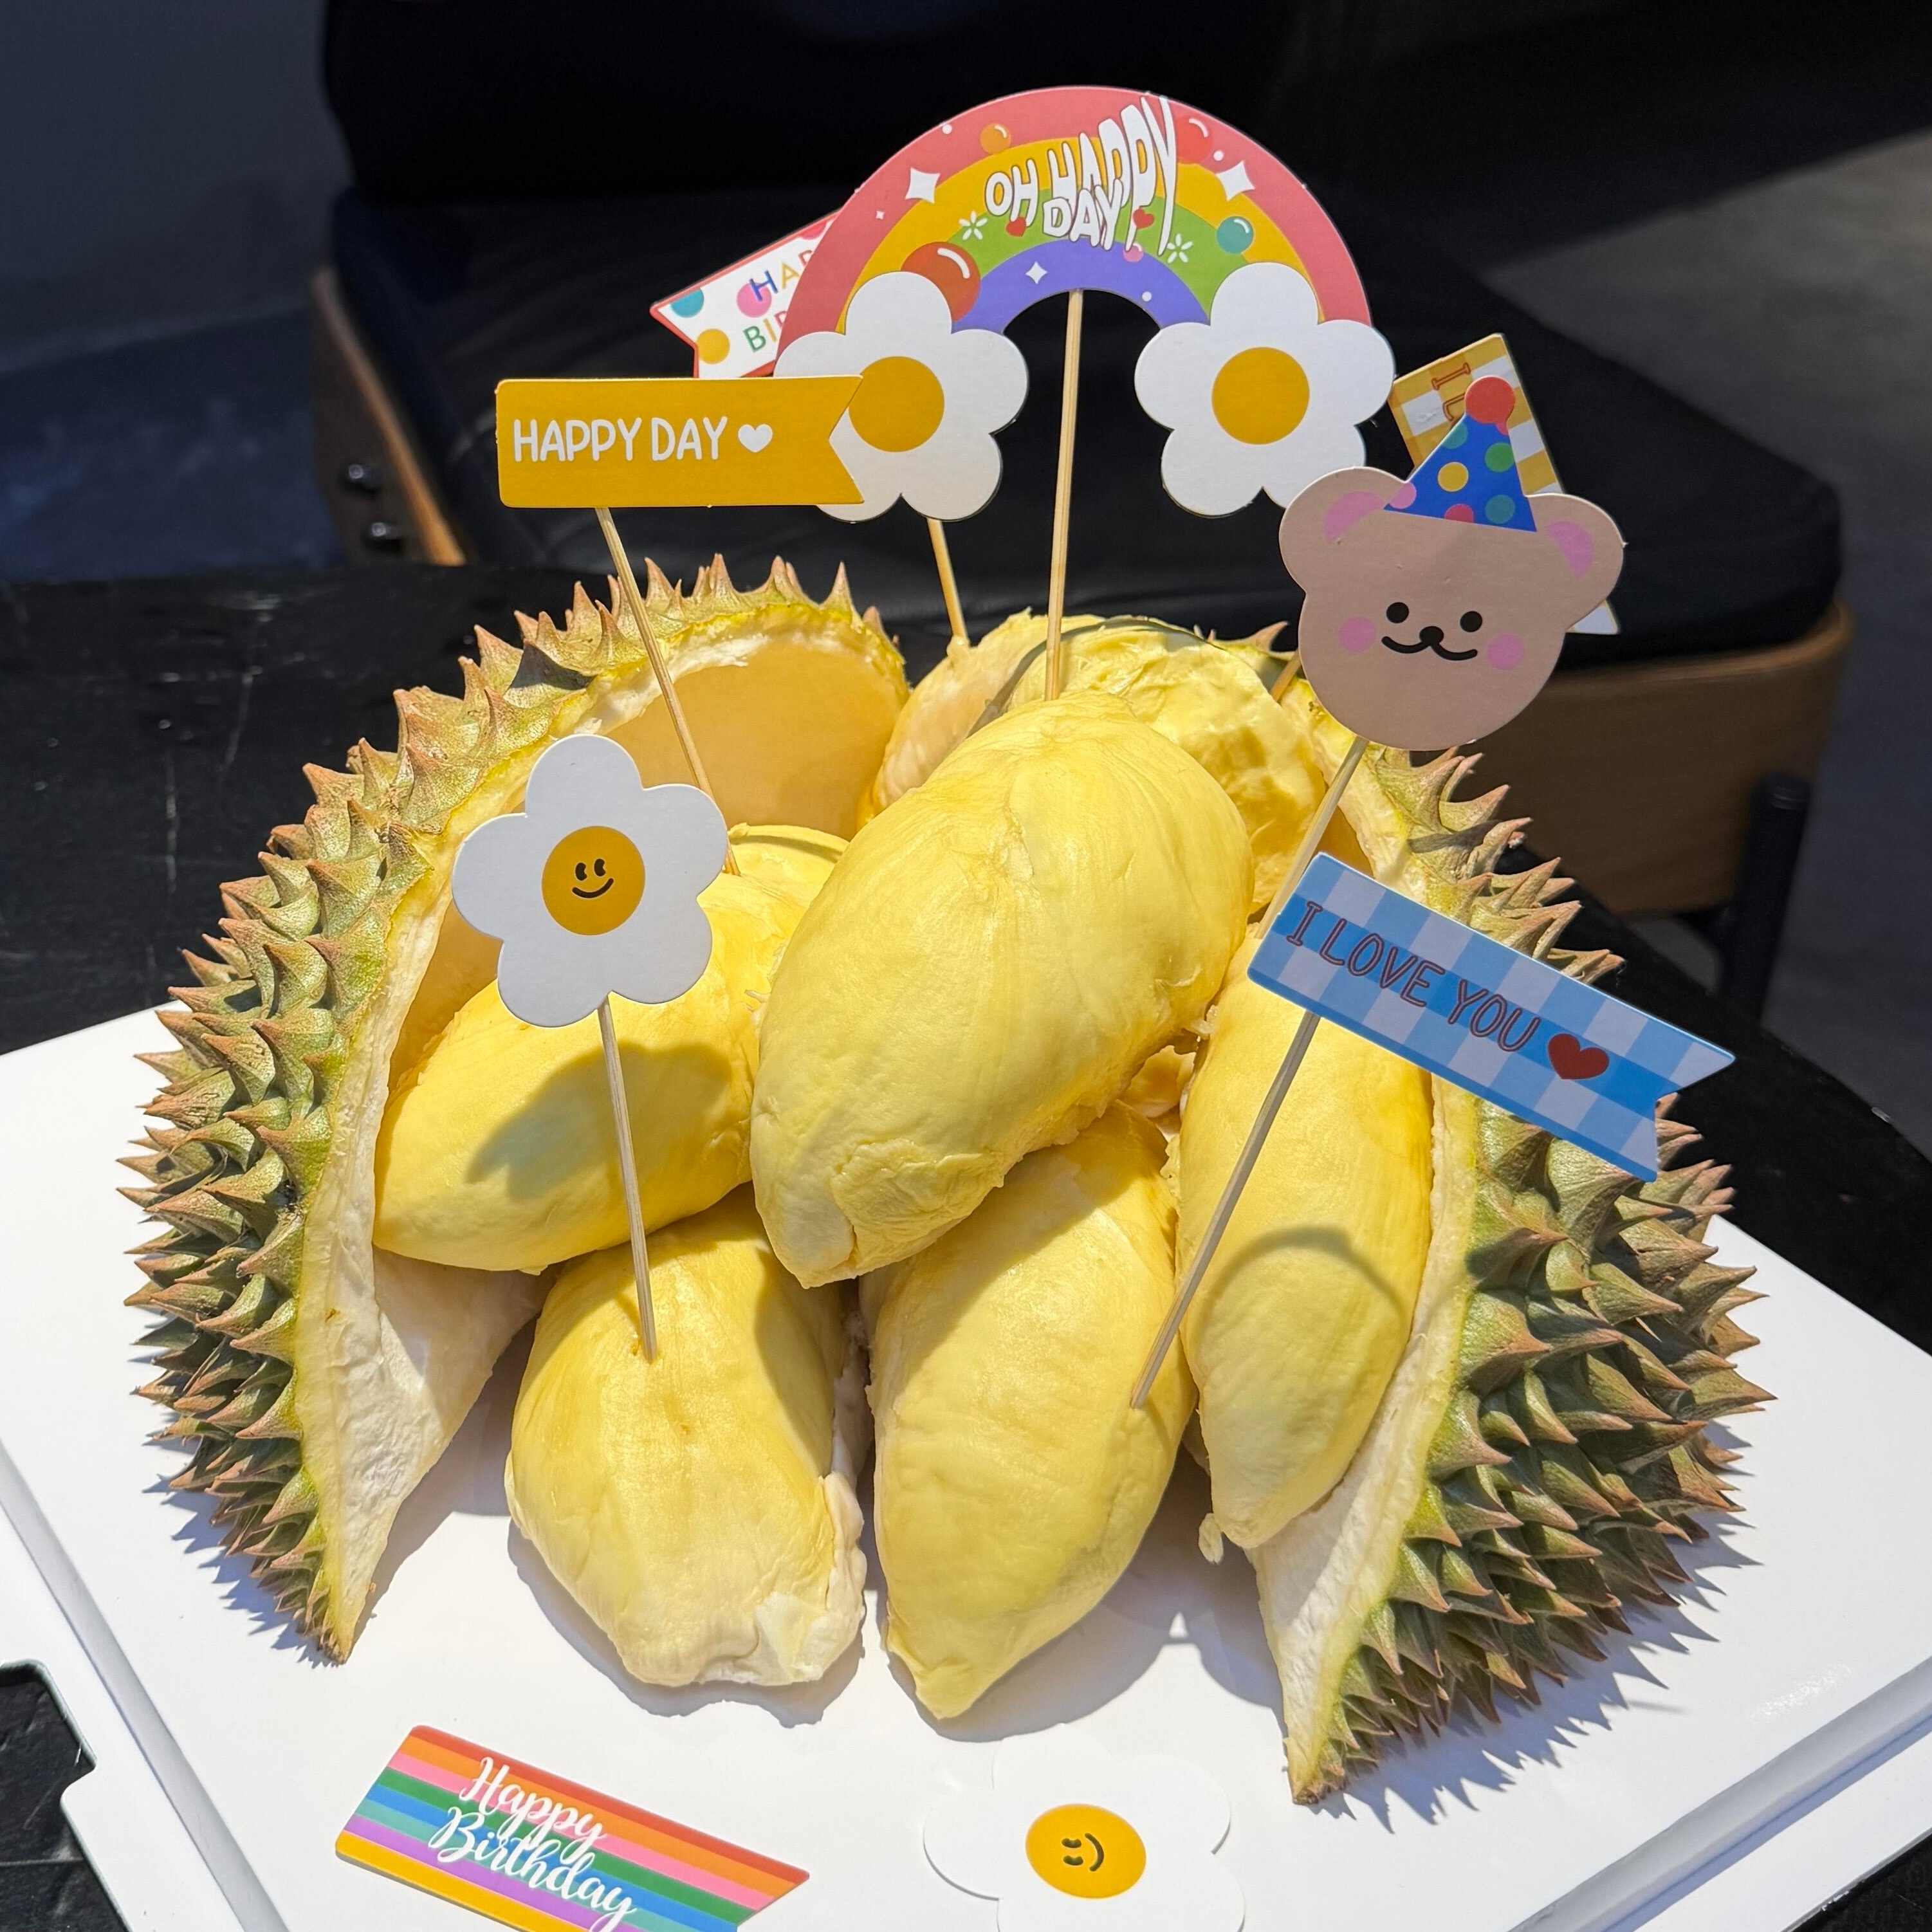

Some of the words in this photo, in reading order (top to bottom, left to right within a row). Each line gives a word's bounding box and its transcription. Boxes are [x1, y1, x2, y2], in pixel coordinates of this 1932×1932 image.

[985, 158, 1039, 228] OH
[1047, 96, 1177, 257] HAPPY
[1042, 178, 1124, 251] DAY
[514, 417, 642, 462] HAPPY
[651, 416, 728, 462] DAY
[1287, 901, 1323, 946] I
[1319, 917, 1446, 1007] LOVE
[1448, 979, 1541, 1052] YOU
[428, 1806, 638, 1932] Birthday
[459, 1756, 608, 1865] Happy
